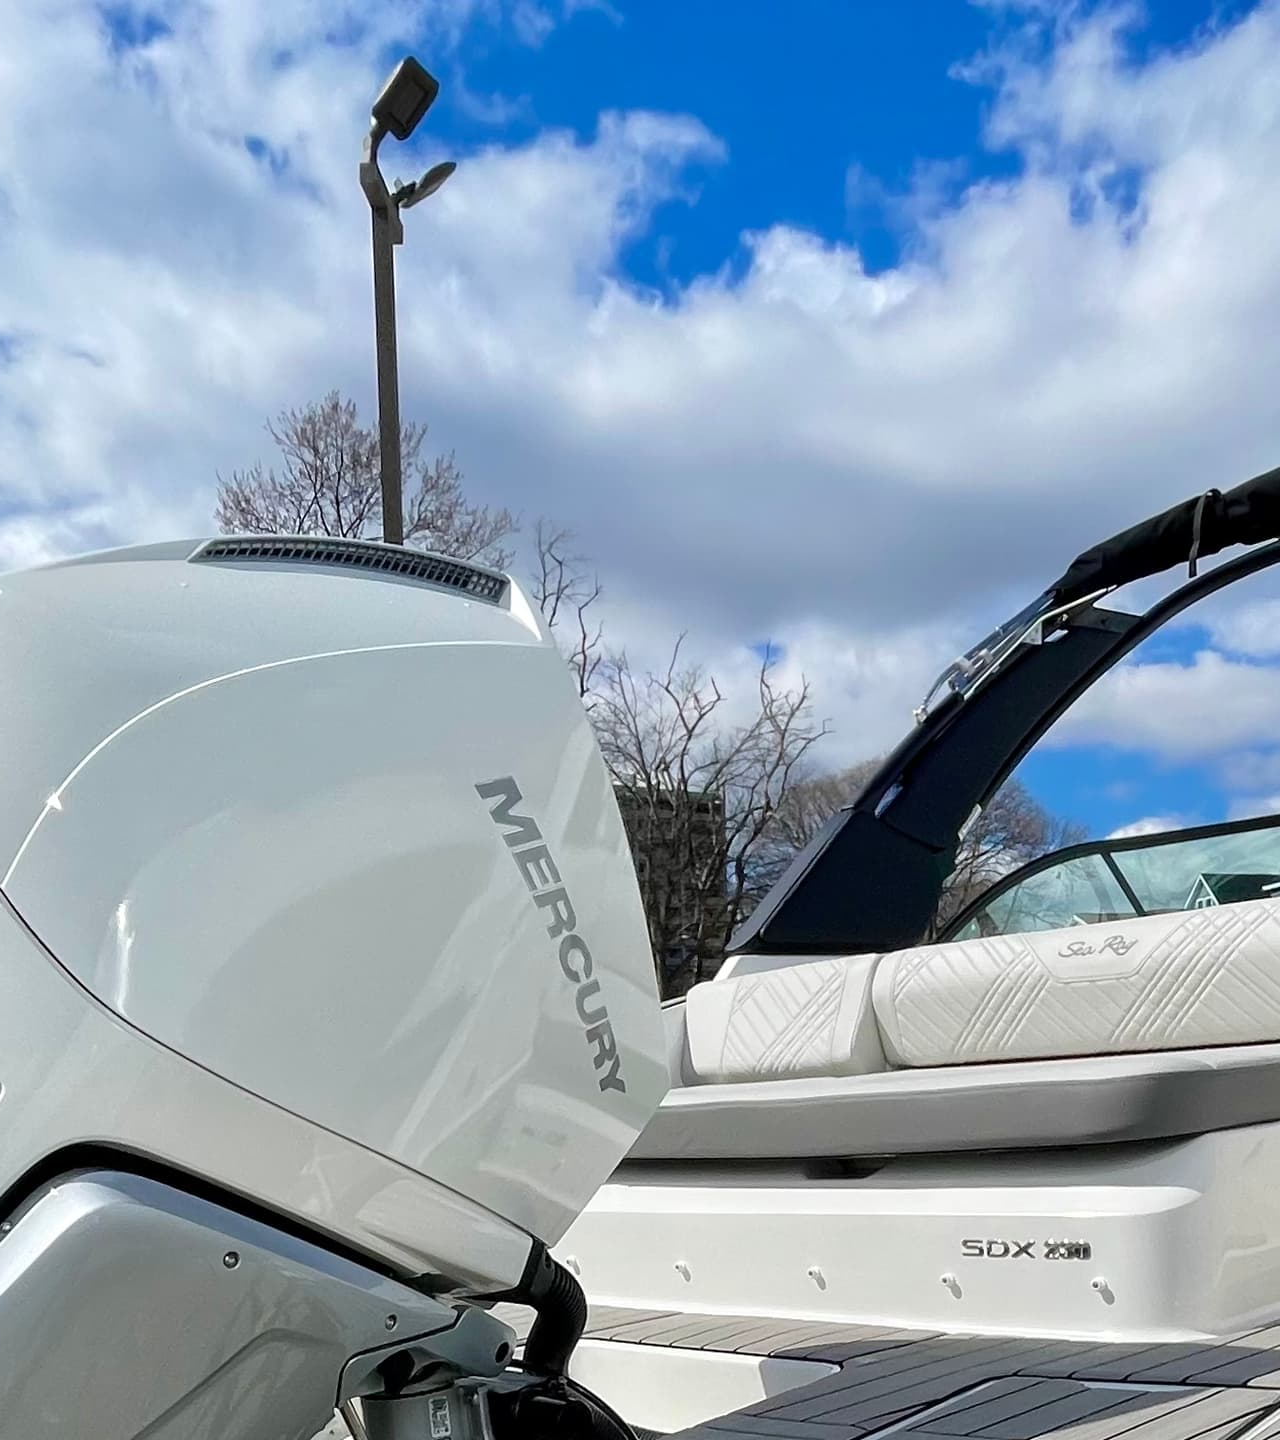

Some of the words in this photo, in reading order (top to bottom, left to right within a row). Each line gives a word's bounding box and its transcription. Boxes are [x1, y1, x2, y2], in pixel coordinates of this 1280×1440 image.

[474, 776, 626, 1093] MERCURY
[1058, 941, 1096, 957] Sea
[1098, 935, 1138, 956] Ray
[961, 1239, 1036, 1259] SDX
